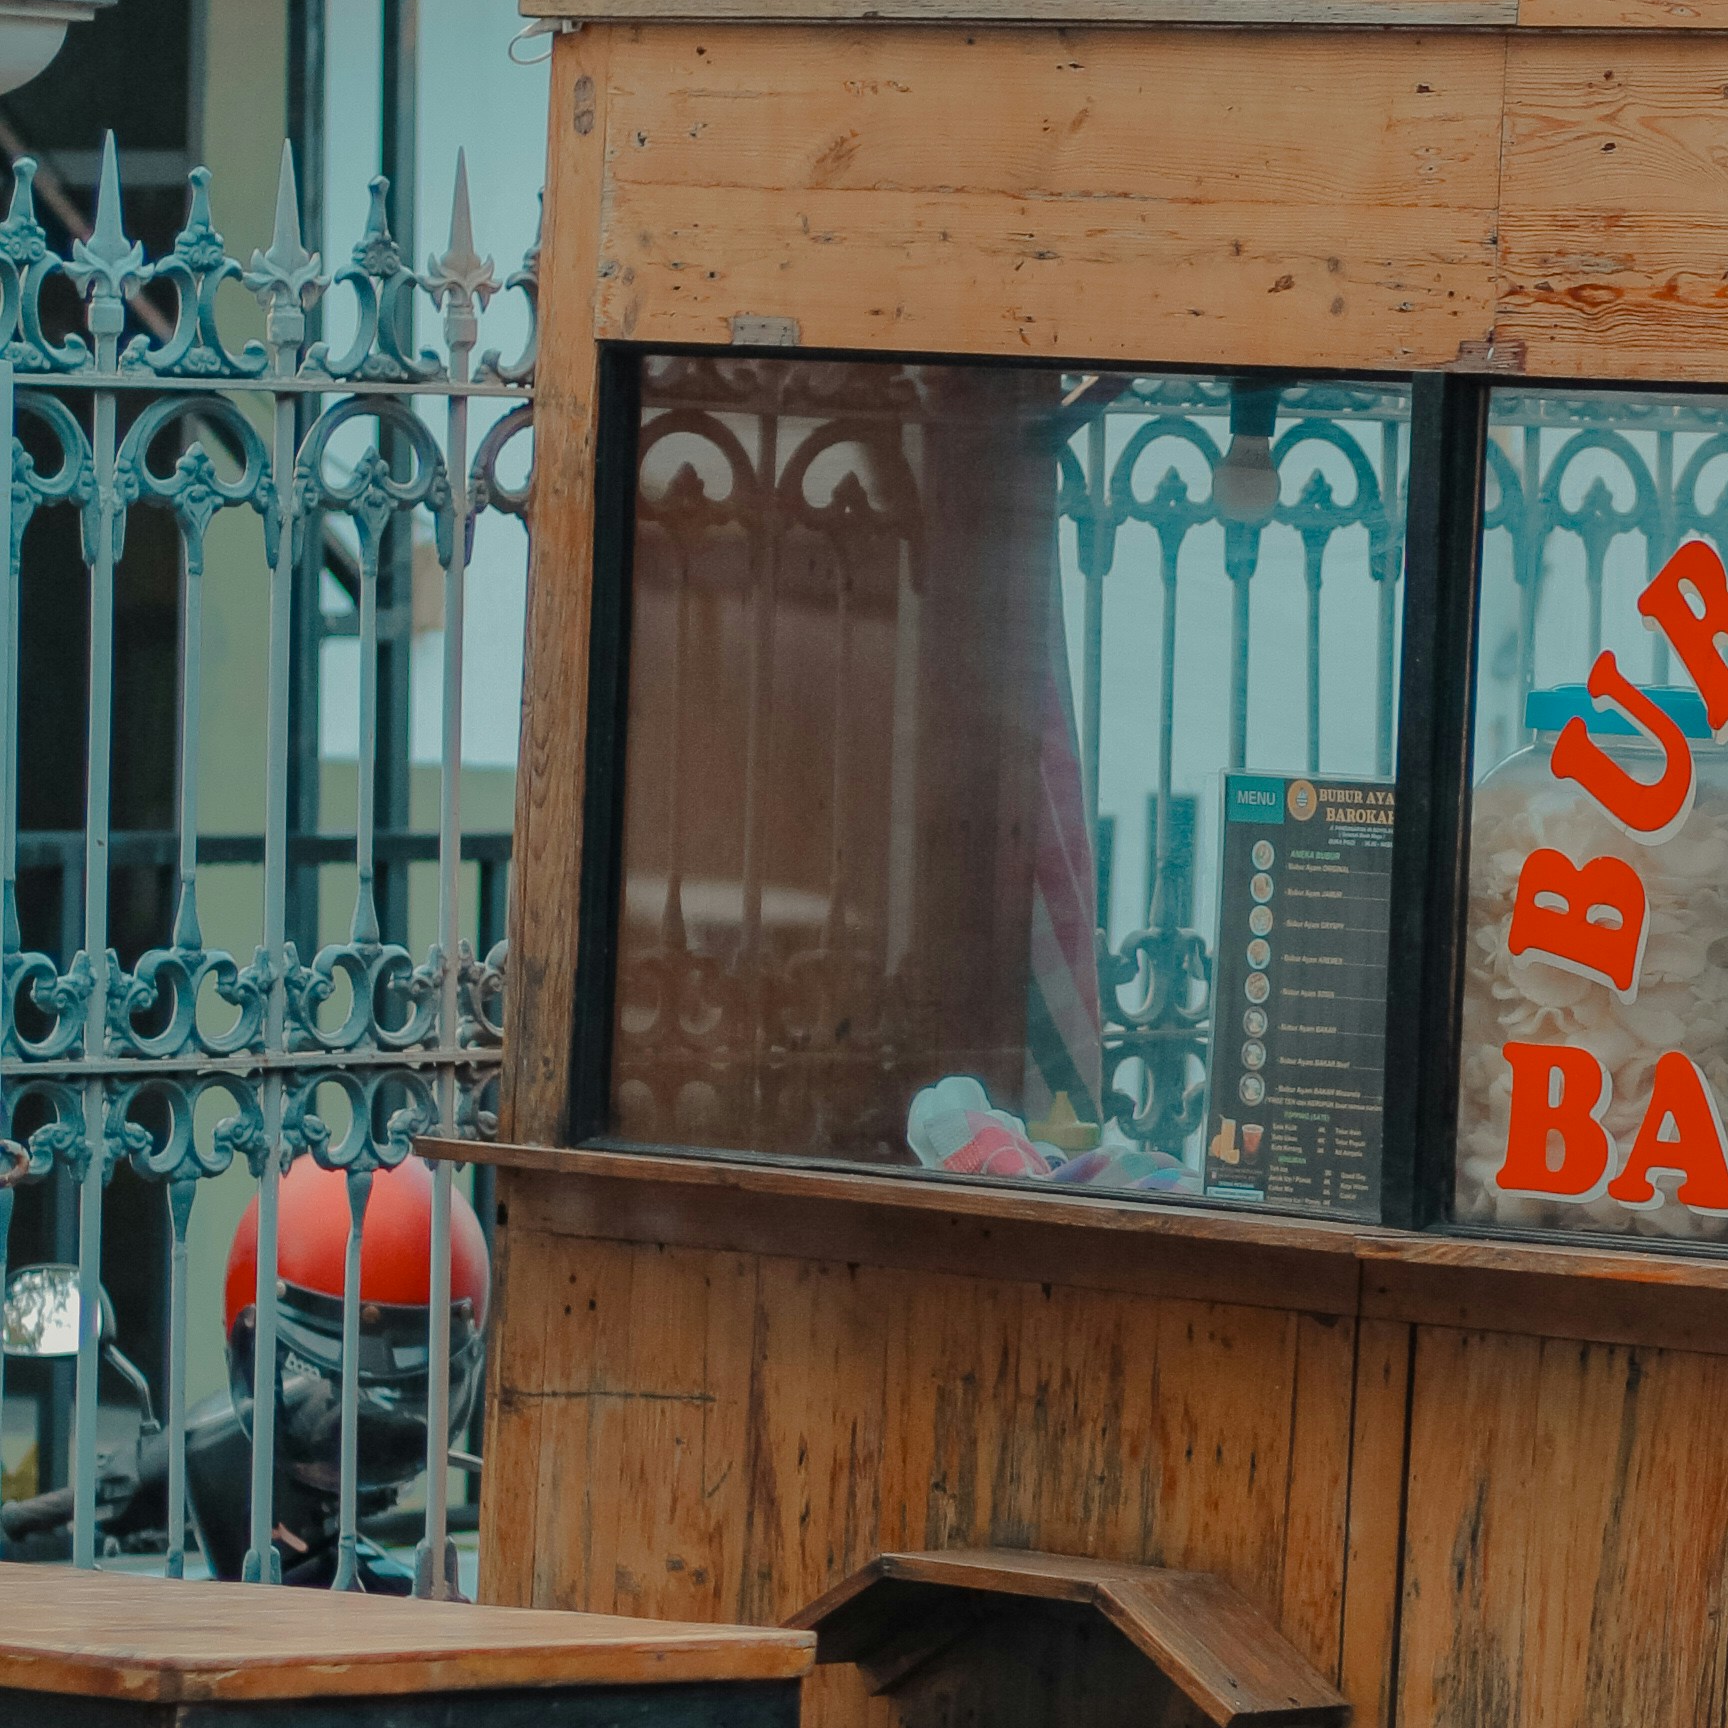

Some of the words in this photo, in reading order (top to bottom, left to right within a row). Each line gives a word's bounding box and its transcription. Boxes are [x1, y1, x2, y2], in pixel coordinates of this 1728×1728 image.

[1237, 790, 1276, 806] MENU
[1319, 788, 1364, 804] BUBUR
[1365, 790, 1395, 806] AYA
